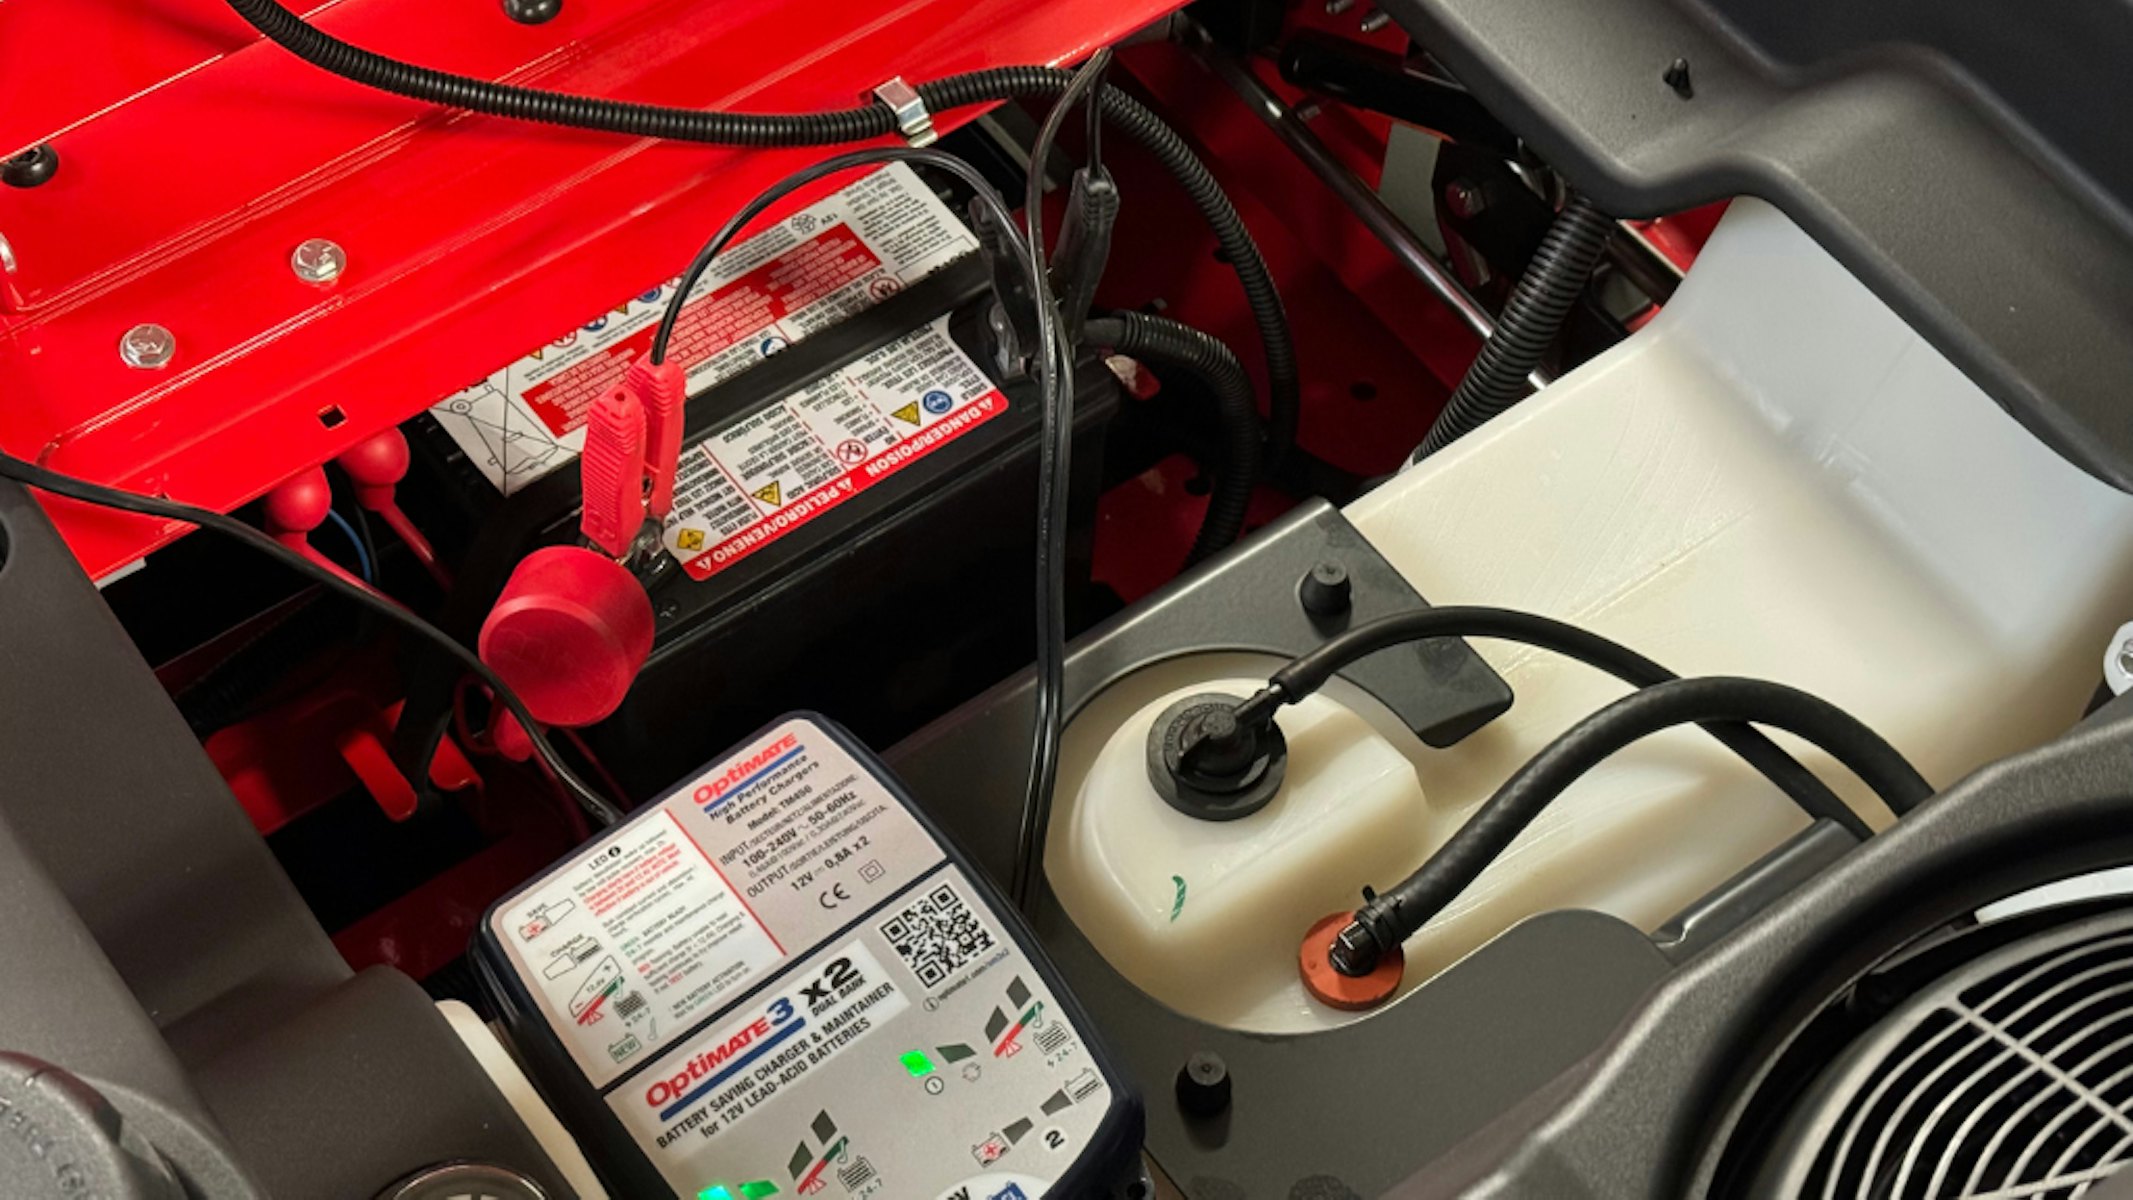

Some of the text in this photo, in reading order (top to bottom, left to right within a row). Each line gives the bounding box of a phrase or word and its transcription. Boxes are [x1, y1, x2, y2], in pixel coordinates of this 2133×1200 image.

[866, 406, 981, 476] DANGER/POISON
[713, 486, 840, 562] PELIGRO/VENENO
[693, 733, 797, 804] OptiMATE
[709, 755, 807, 821] High Performance
[725, 761, 819, 824] Battery Chargers
[791, 871, 814, 891] 12V
[824, 847, 853, 869] 0,8A
[799, 957, 859, 1006] x2
[811, 975, 866, 1017] DUAL BANK
[656, 982, 894, 1149] BATTERY SAVING CHARGER & MAINTAINER
[700, 1017, 871, 1138] for 12V LEAD-ACID BATTERIES
[1055, 1041, 1077, 1062] 24-7
[1045, 1130, 1065, 1149] 2
